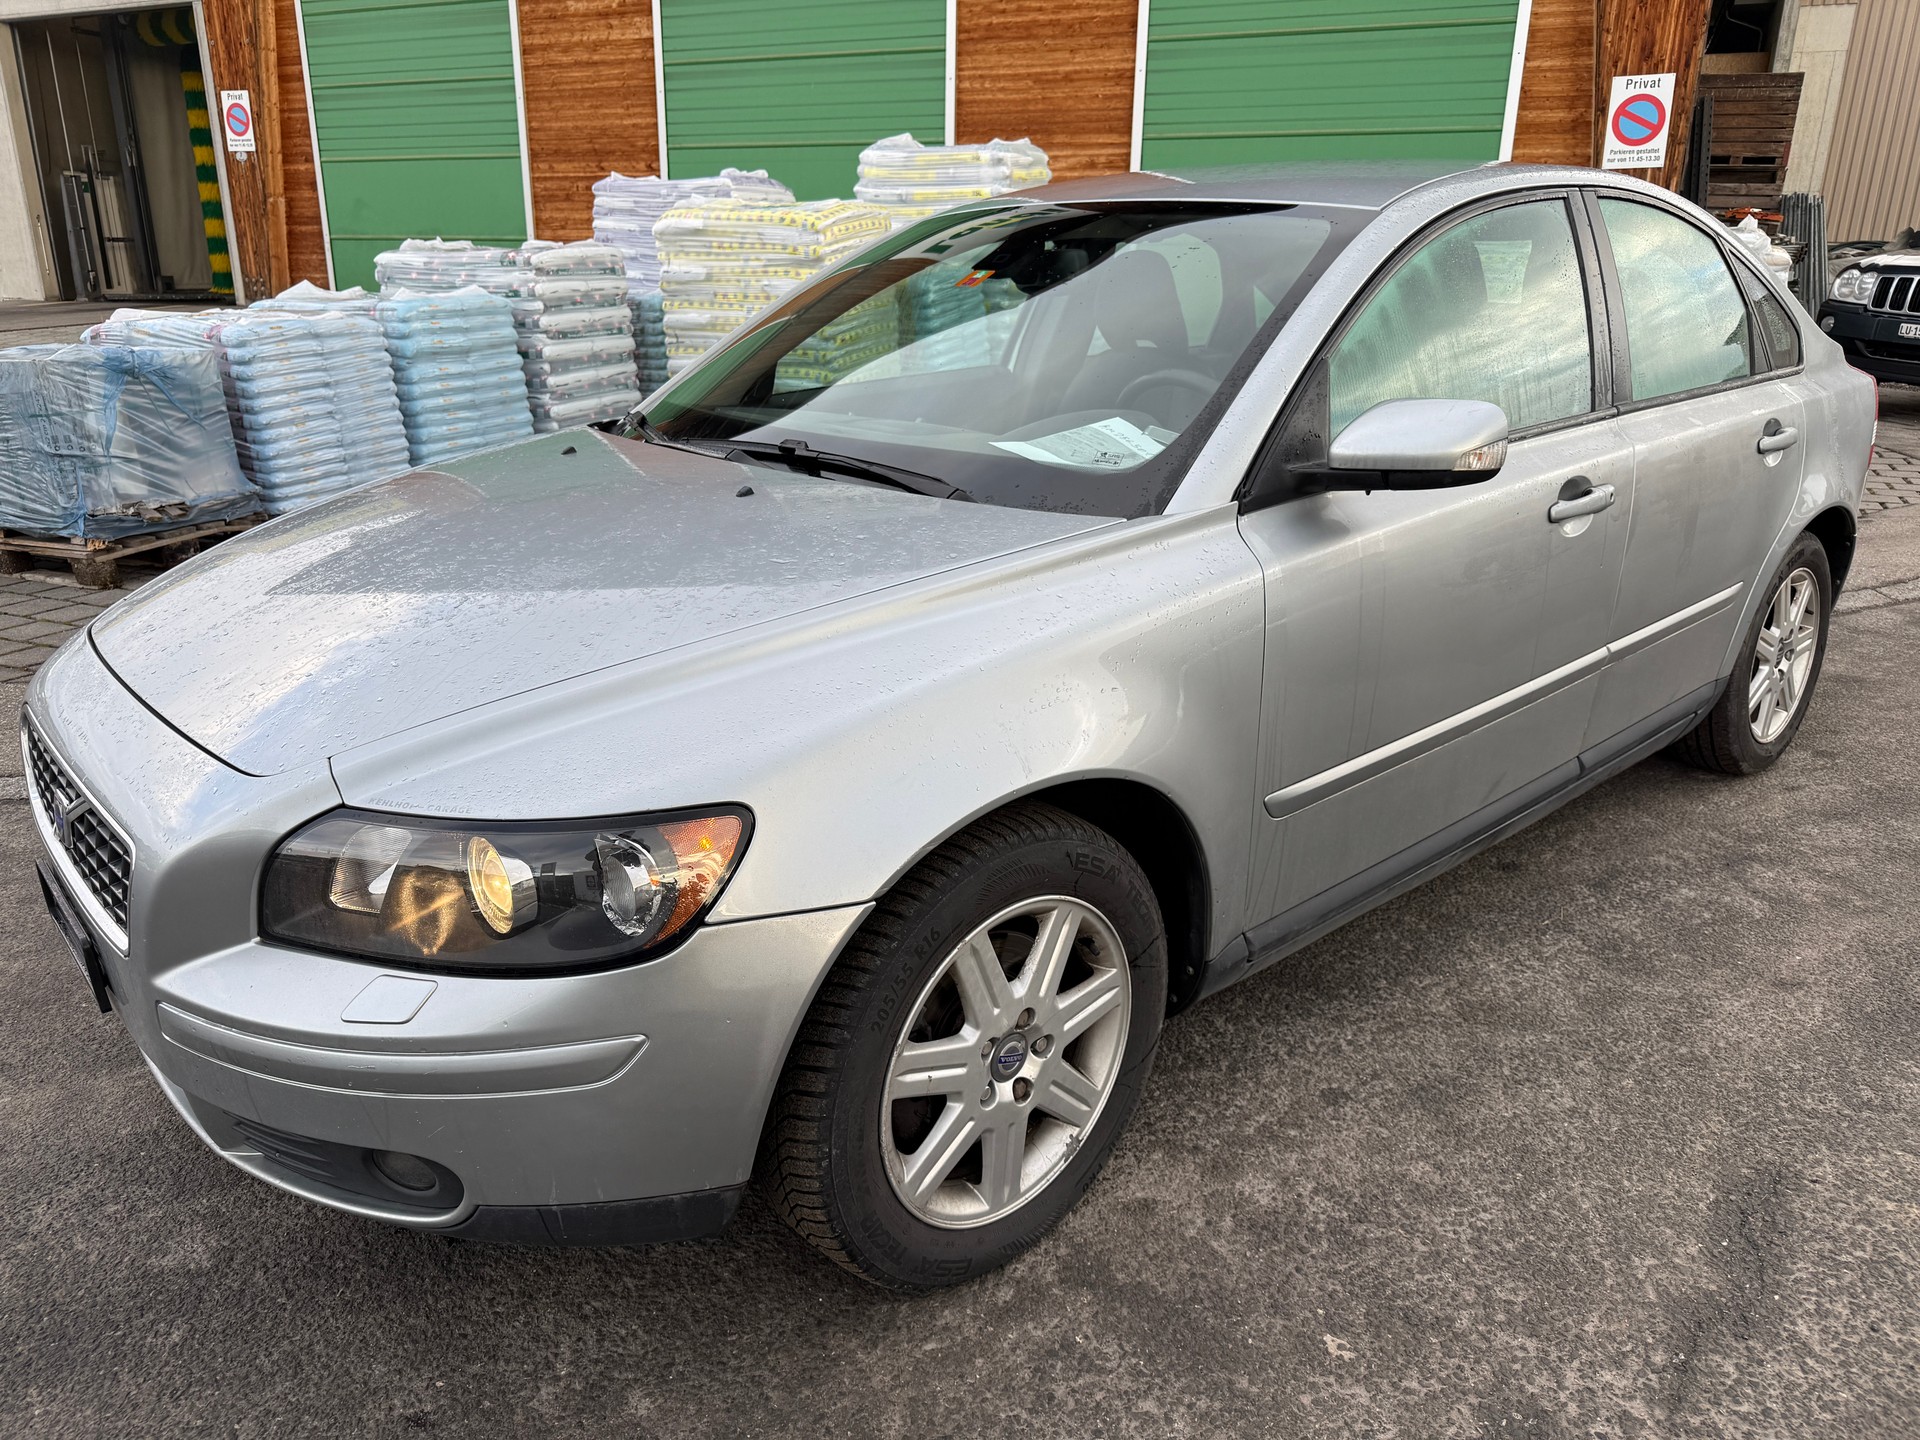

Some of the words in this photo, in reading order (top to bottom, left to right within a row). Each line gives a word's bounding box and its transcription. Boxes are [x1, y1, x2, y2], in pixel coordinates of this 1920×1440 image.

[1625, 77, 1662, 90] Privat
[227, 92, 243, 101] Privat
[1636, 147, 1660, 155] gestattet
[427, 804, 473, 814] GARAGE
[871, 962, 914, 1034] 205/55
[913, 926, 941, 961] R16
[1000, 1055, 1023, 1063] VOLVO
